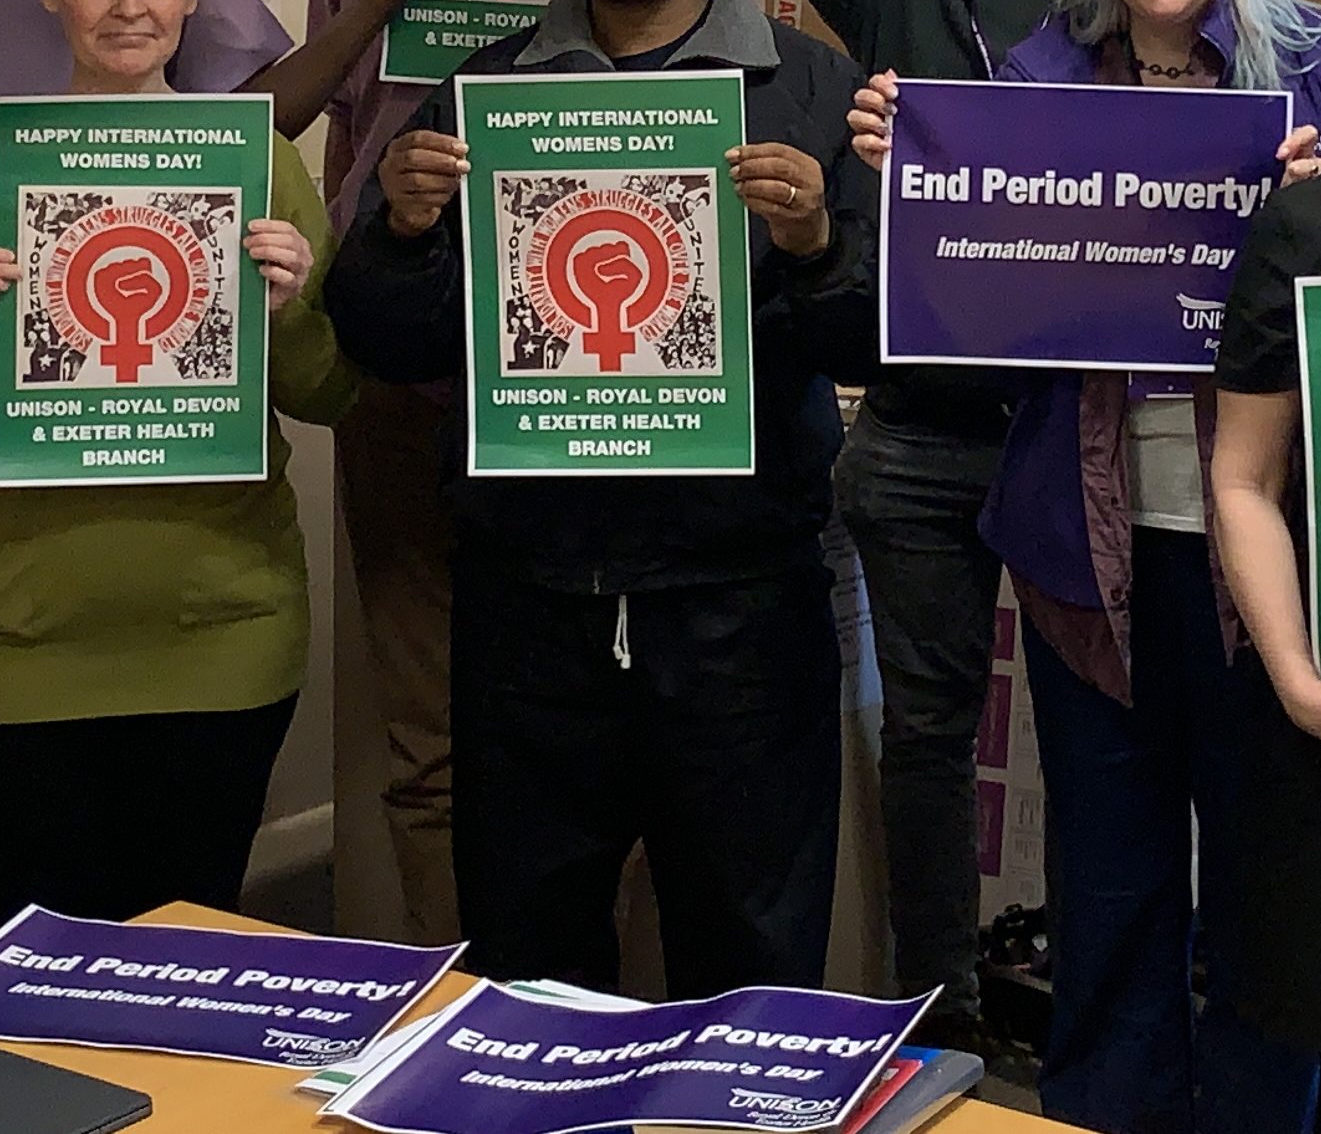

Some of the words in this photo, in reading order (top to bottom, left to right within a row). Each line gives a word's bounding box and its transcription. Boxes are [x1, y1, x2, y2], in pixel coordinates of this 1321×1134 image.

[404, 8, 467, 24] UNISON
[425, 32, 436, 45] &
[442, 33, 505, 47] EXET
[487, 112, 553, 127] HAPPY
[559, 109, 718, 126] INTERNATIONAL
[16, 129, 82, 143] HAPPY
[88, 129, 246, 144] INTERNATIONAL
[532, 137, 622, 152] WOMENS
[628, 136, 673, 150] DAY!
[60, 153, 150, 168] WOMENS
[156, 154, 201, 169] DAY!
[902, 164, 969, 201] End
[983, 168, 1102, 206] Period
[1115, 173, 1271, 217] Poverty!
[508, 221, 525, 296] WOMEN
[683, 219, 705, 293] UNITE
[937, 237, 1080, 260] International
[1086, 241, 1186, 264] Women's
[1191, 244, 1235, 269] Day
[29, 236, 47, 309] WOMEN
[207, 238, 225, 307] UNITE
[1183, 310, 1224, 329] UNI
[493, 389, 566, 404] UNISON
[587, 389, 652, 404] ROYAL
[659, 388, 725, 403] DEVON
[7, 401, 81, 417] UNISON
[102, 399, 167, 414] ROYAL
[174, 398, 239, 413] DEVON
[519, 415, 532, 430] &
[539, 415, 616, 430] EXETER
[623, 414, 700, 429] HEALTH
[33, 427, 46, 441] &
[53, 425, 131, 441] EXETER
[137, 423, 214, 439] HEALTH
[569, 440, 650, 455] BRANCH
[83, 449, 164, 466] BRANCH
[86, 958, 229, 984] Period
[234, 970, 416, 1000] Poverty!
[8, 983, 176, 1005] International
[176, 997, 294, 1016] Women's
[297, 1008, 351, 1022] Day
[262, 1036, 366, 1052] UNISON
[447, 1028, 539, 1060] End
[542, 1031, 690, 1064] Period
[695, 1025, 892, 1057] Poverty!
[461, 1070, 636, 1091] International
[637, 1060, 762, 1077] Women's
[765, 1066, 823, 1080] Day
[728, 1096, 842, 1112] UNISON
